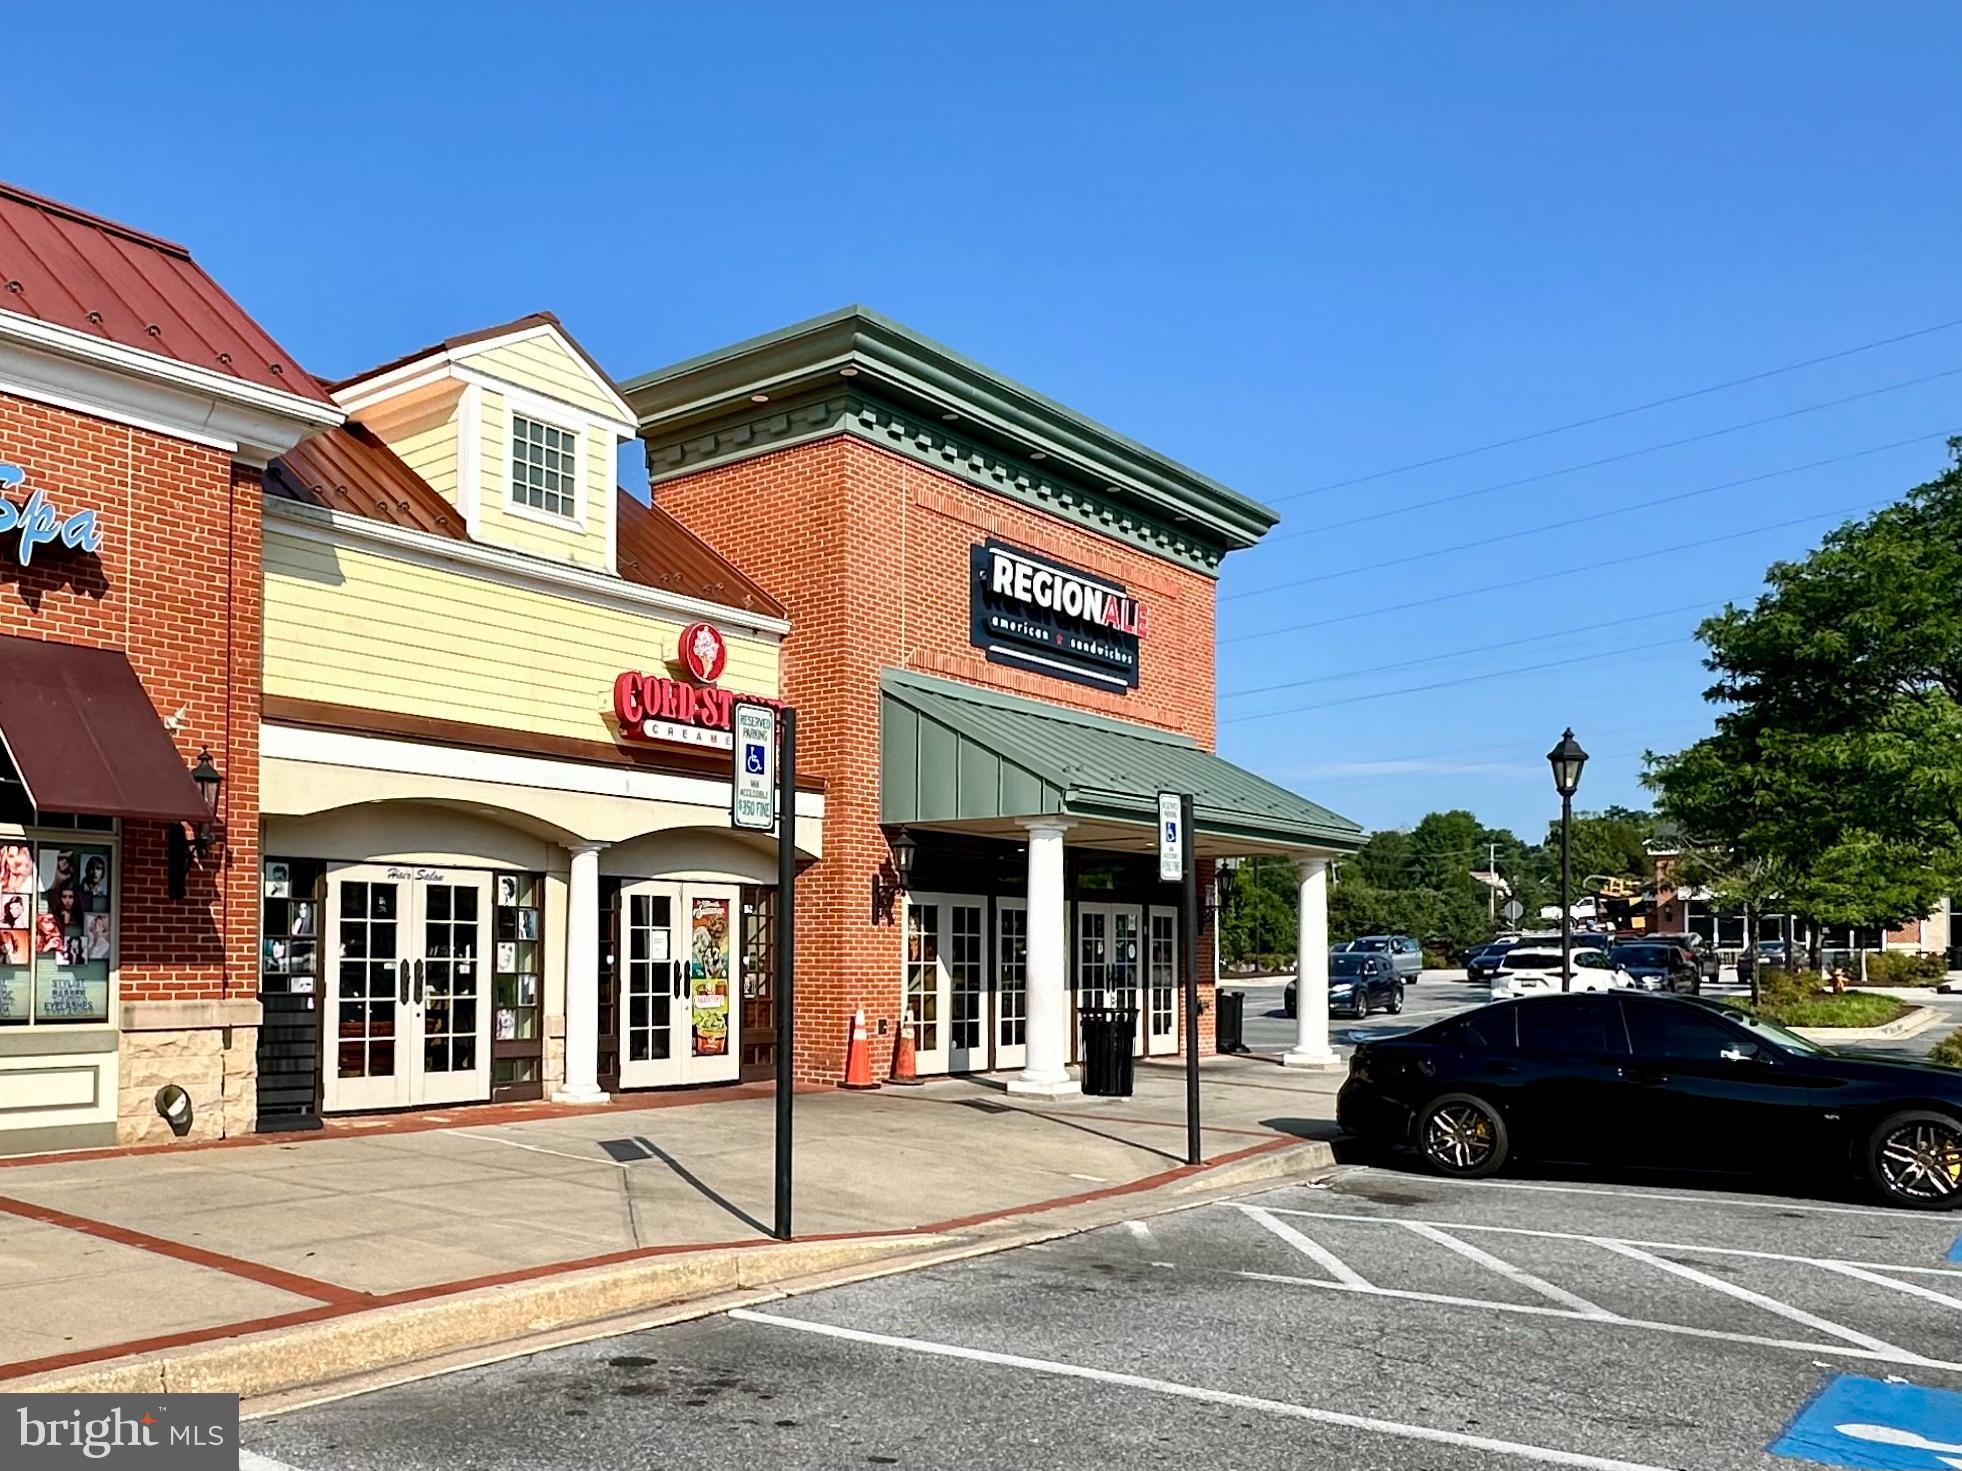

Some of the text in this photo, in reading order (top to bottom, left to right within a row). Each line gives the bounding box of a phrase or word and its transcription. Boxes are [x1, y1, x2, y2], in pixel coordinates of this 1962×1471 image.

[993, 554, 1149, 640] REGIONALE
[992, 615, 1133, 665] american sandwiches
[614, 671, 696, 723] COLD
[740, 714, 771, 730] RESERVED
[652, 723, 731, 746] CREAME
[743, 727, 768, 742] PARKING
[740, 788, 769, 800] ACCESSIBLE
[756, 802, 770, 818] FINE
[387, 867, 445, 882] Hair Salon
[43, 1001, 93, 1012] EYELASHES
